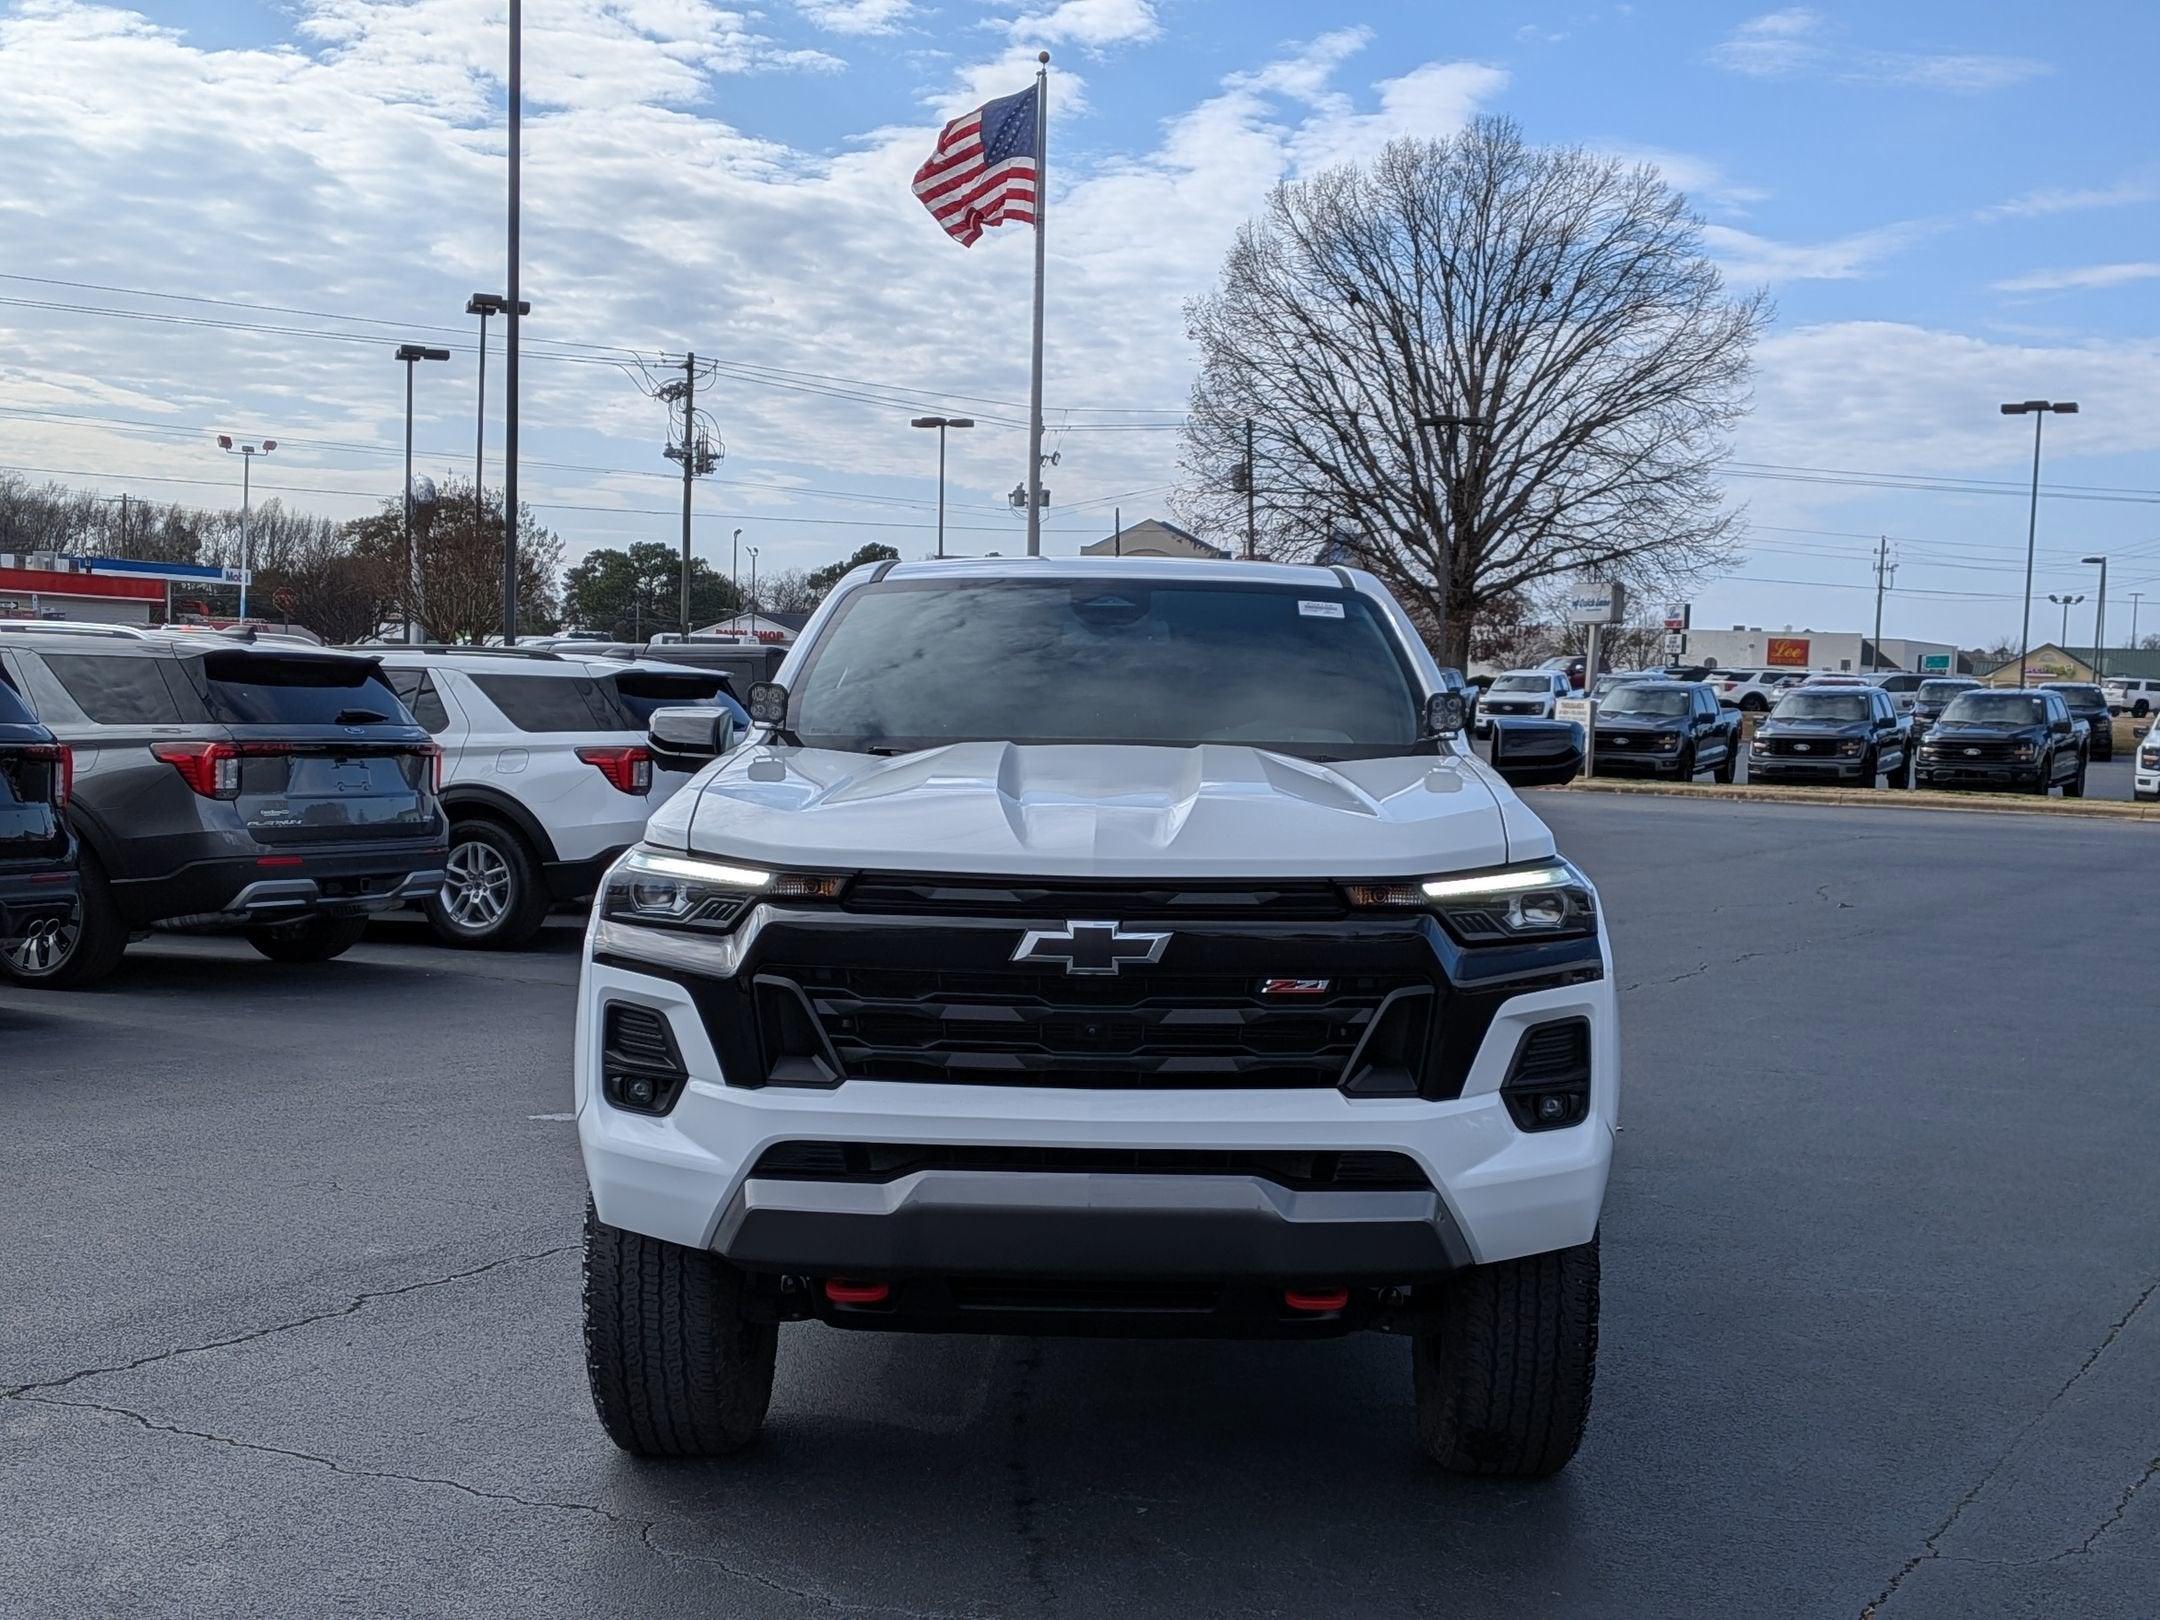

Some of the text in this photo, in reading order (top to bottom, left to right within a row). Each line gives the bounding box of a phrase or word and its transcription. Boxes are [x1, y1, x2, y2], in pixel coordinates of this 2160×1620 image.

[225, 571, 249, 583] Mobl
[752, 630, 784, 641] SHOP
[1771, 640, 1803, 658] Lee
[1261, 979, 1330, 993] Z71
